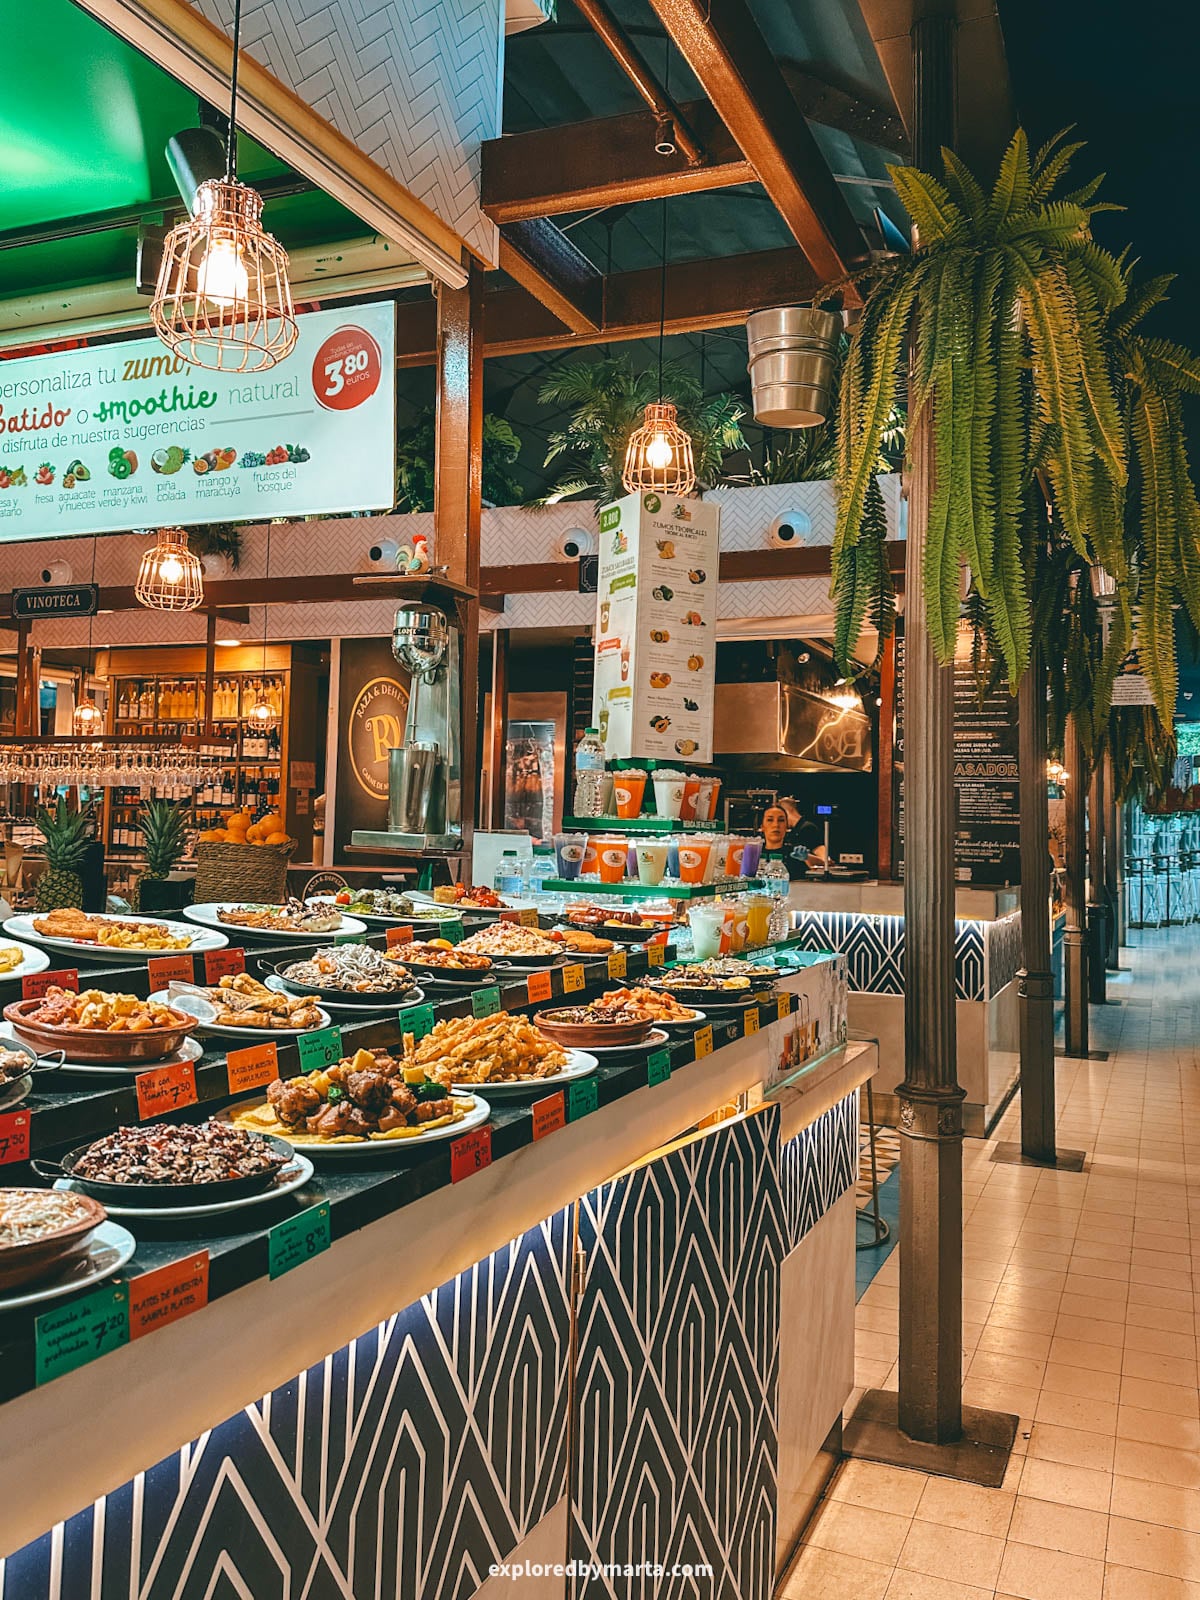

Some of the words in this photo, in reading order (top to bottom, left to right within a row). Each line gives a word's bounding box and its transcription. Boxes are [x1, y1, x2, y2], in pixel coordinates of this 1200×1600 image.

[98, 367, 117, 385] tu
[346, 371, 370, 386] euros
[76, 409, 89, 425] o
[93, 383, 218, 424] smoothie
[228, 376, 301, 406] natural
[3, 436, 48, 455] disfruta
[51, 432, 68, 448] de
[71, 428, 120, 446] nuestra
[120, 416, 206, 441] sugerencias
[198, 476, 231, 489] mango
[232, 476, 239, 486] y
[252, 470, 280, 483] frutos
[282, 468, 297, 480] del
[103, 484, 143, 498] manzana
[156, 480, 176, 494] piña
[257, 481, 293, 495] bosque
[35, 494, 54, 505] fresa
[58, 489, 96, 503] aguacate
[98, 496, 122, 509] verde
[130, 494, 149, 505] kiwi
[156, 489, 186, 503] colada
[65, 501, 96, 512] nueces
[26, 593, 81, 609] VINOTECA
[356, 691, 374, 718] RAZA
[373, 686, 380, 697] &
[953, 763, 1019, 777] ASADOR
